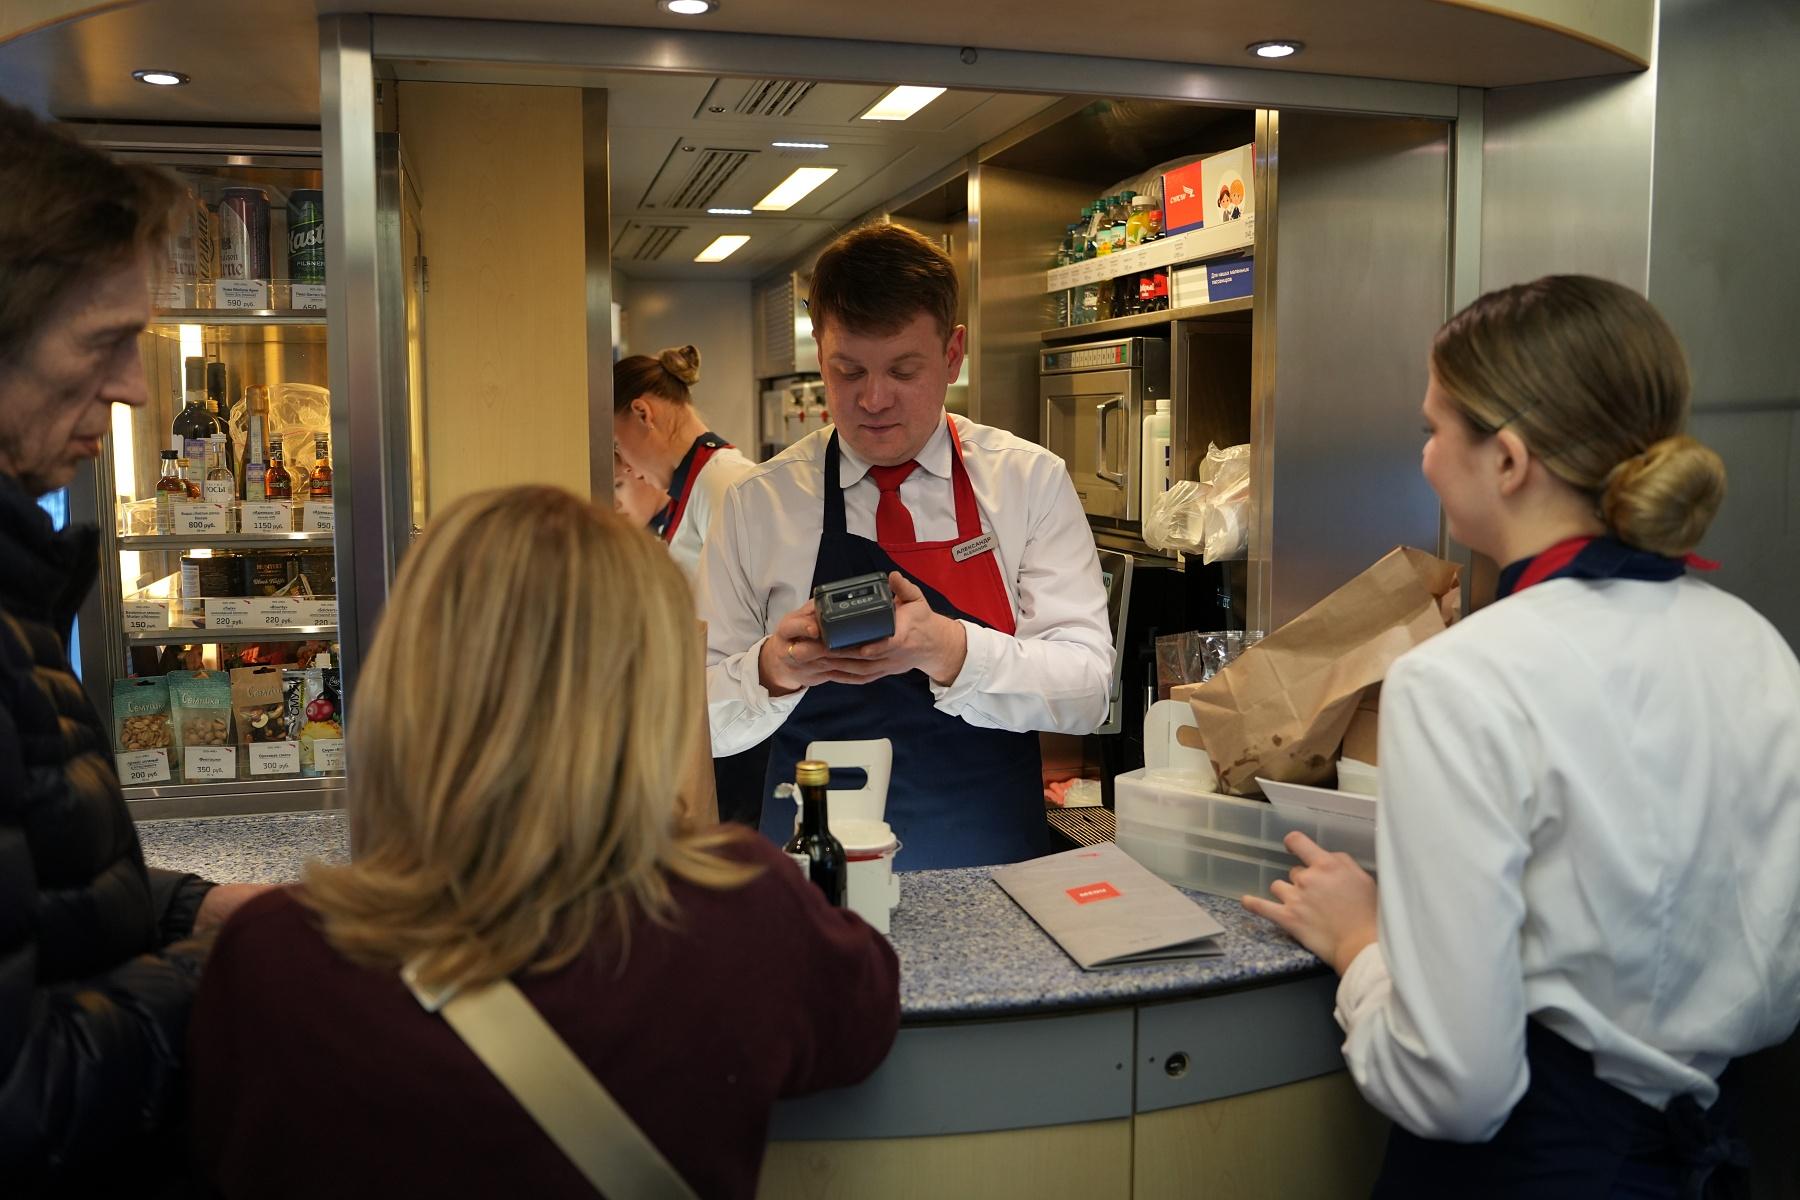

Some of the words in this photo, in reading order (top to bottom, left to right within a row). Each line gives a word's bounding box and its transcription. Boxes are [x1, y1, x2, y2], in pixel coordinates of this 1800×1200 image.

[227, 299, 242, 307] 590
[188, 521, 203, 529] 800
[317, 521, 331, 530] 950
[956, 536, 992, 555] АЛЕКСАНДР
[851, 596, 873, 607] СБЕР
[216, 617, 230, 625] 220
[265, 616, 279, 624] 220
[263, 762, 277, 770] 300
[130, 771, 146, 780] 200
